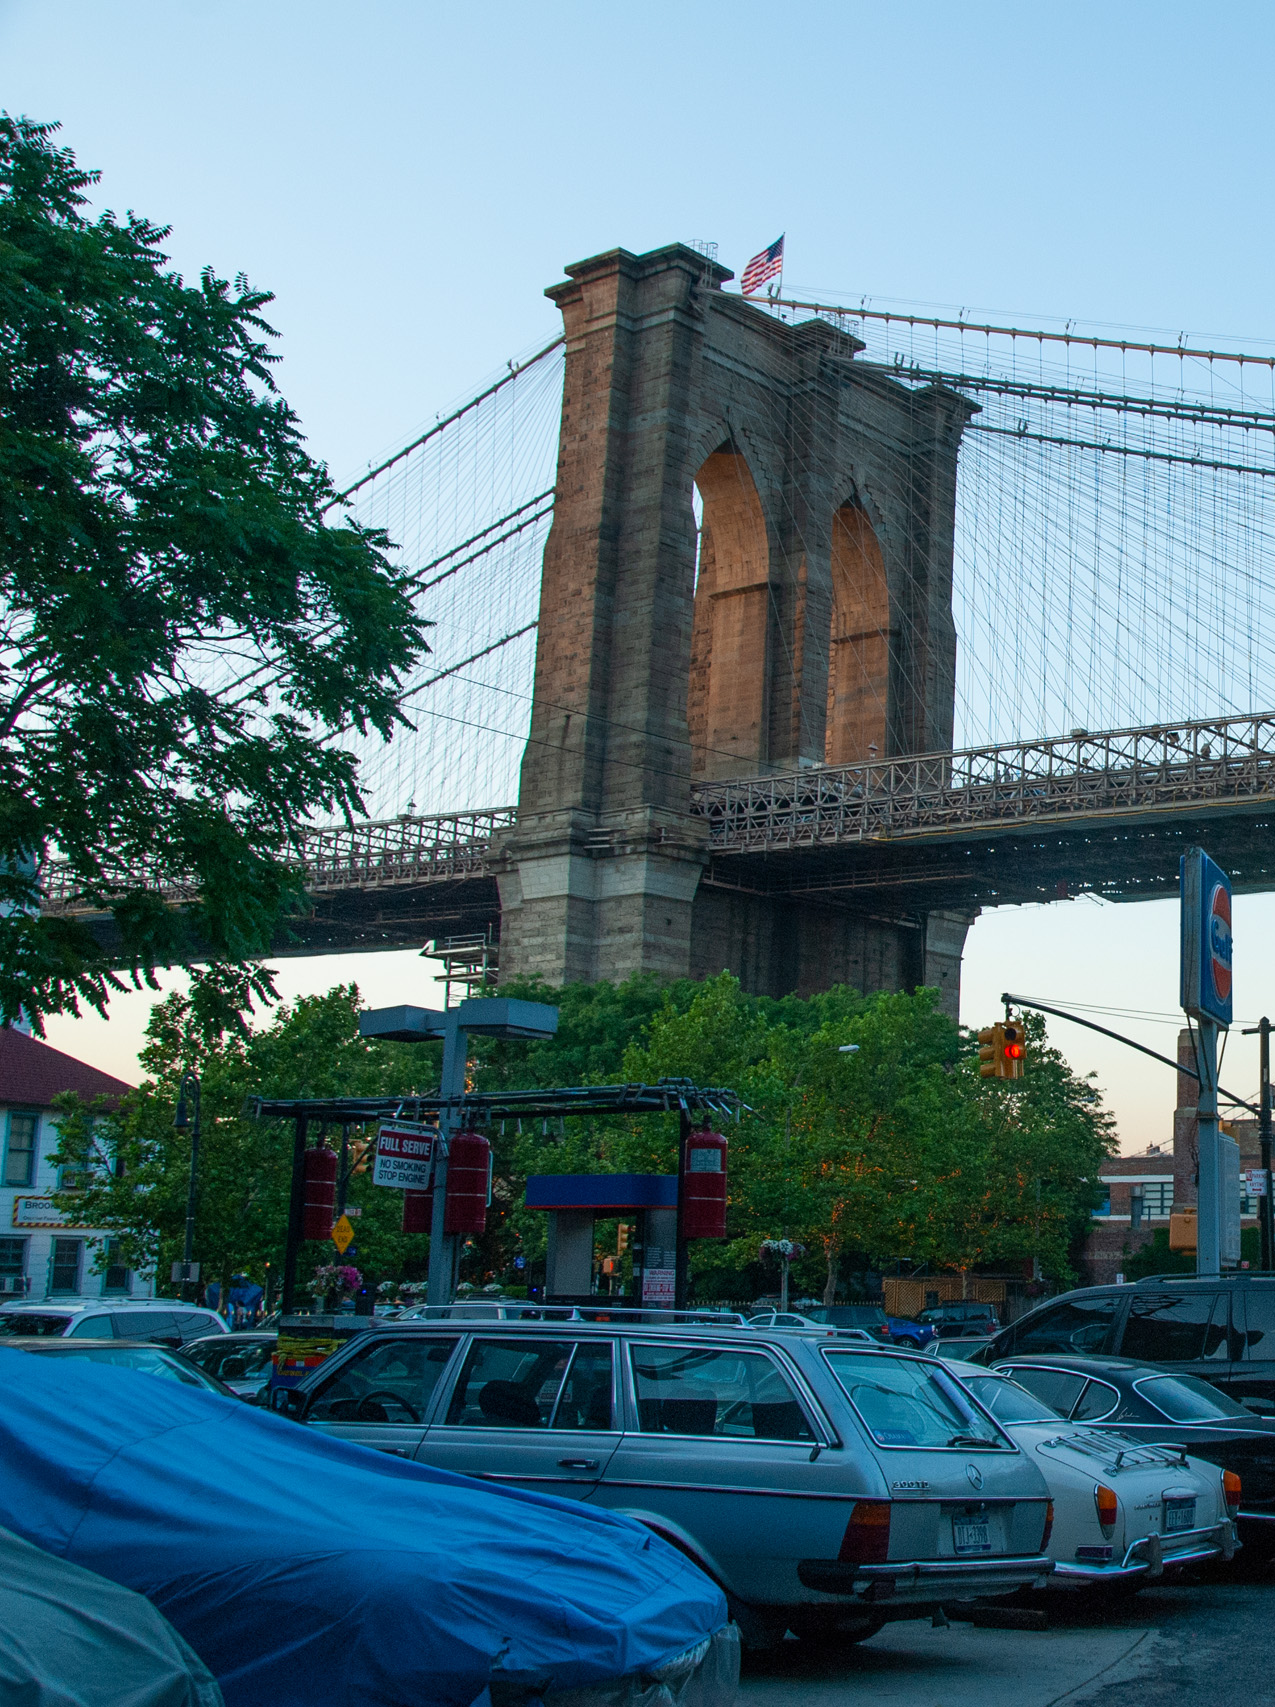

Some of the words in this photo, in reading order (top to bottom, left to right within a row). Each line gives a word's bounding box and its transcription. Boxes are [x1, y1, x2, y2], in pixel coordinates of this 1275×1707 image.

[380, 1136, 400, 1152] FULL
[402, 1140, 431, 1156] SERVE
[380, 1159, 392, 1169] NO
[393, 1160, 427, 1173] SMOKING
[378, 1169, 398, 1181] STOP
[399, 1171, 426, 1184] ENGINE
